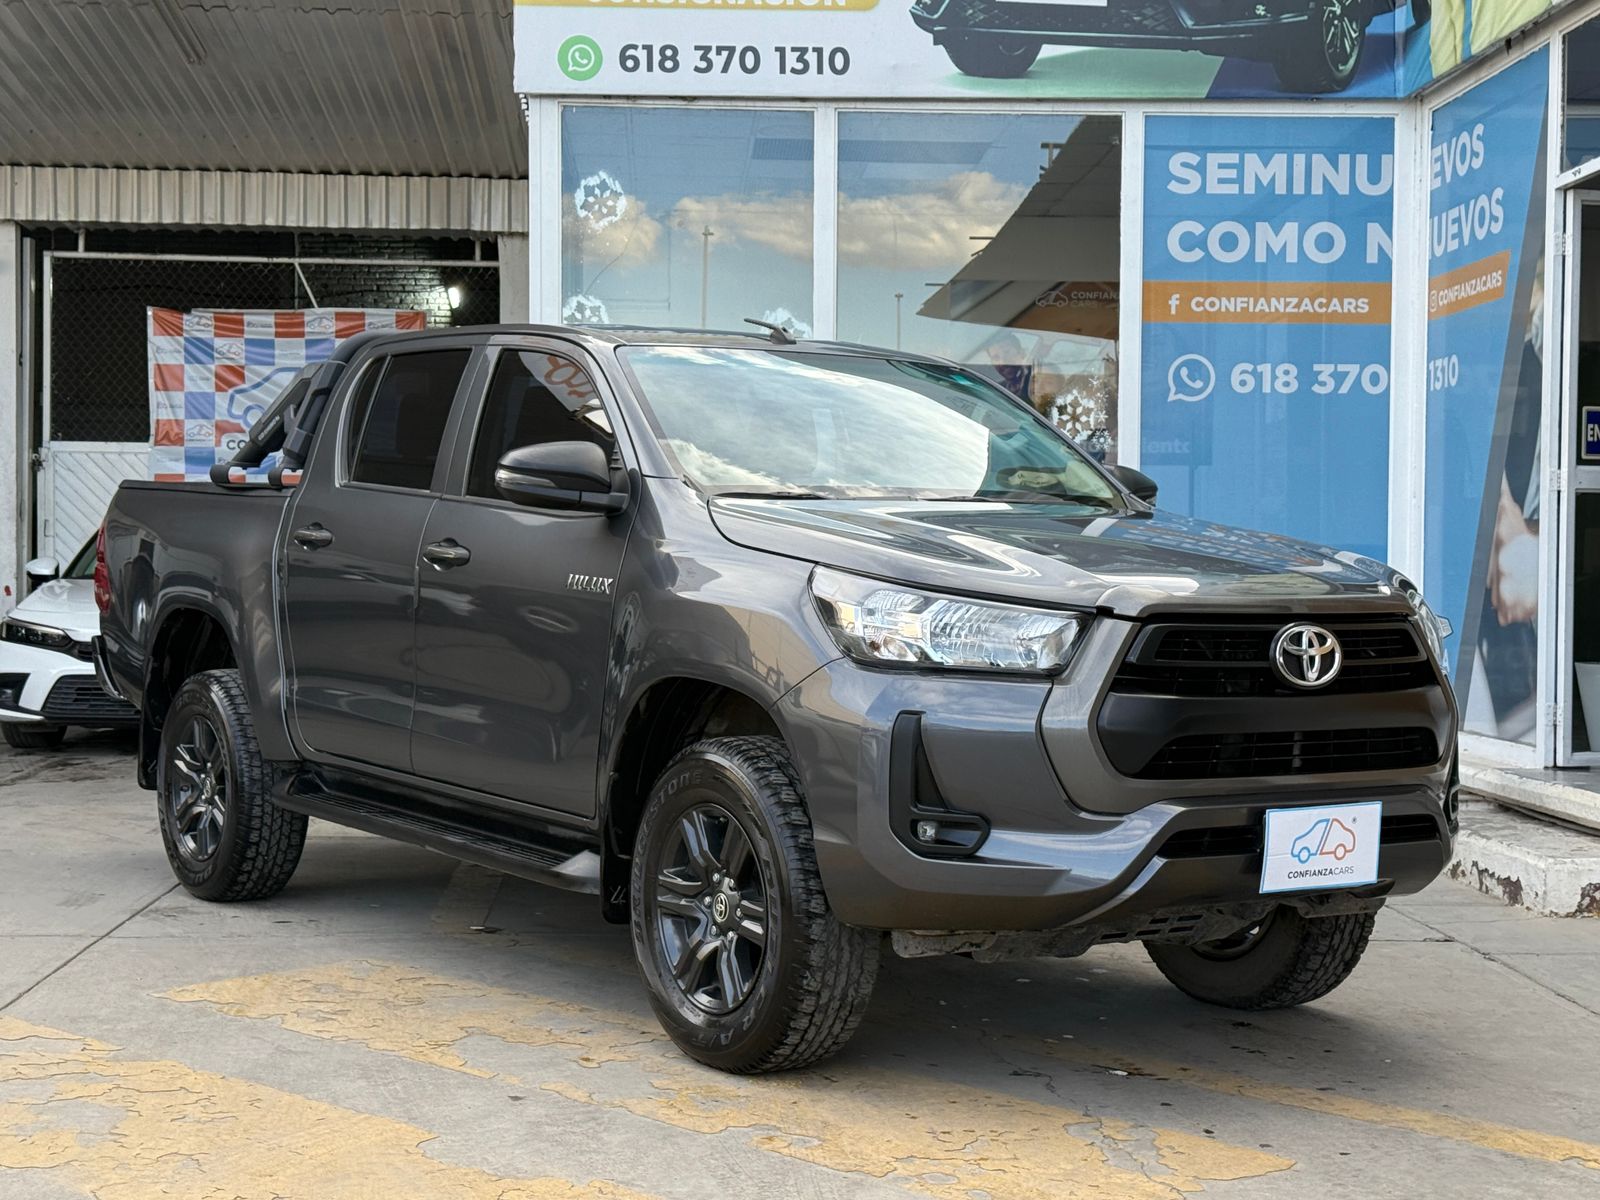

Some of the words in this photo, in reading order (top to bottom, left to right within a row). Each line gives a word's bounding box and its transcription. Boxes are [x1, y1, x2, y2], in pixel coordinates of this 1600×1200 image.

[618, 43, 680, 74] 618
[693, 45, 761, 75] 370
[774, 46, 851, 76] 1310
[1167, 151, 1394, 196] SEMINU
[1430, 122, 1485, 191] EVOS
[1429, 186, 1504, 259] UEVOS
[1166, 220, 1347, 264] COMO
[1190, 296, 1370, 314] CONFIANZACARS
[1439, 270, 1502, 306] CONFIANZACARS
[1230, 362, 1299, 394] 618
[1311, 363, 1389, 395] 370
[1428, 354, 1459, 392] 1310
[1287, 867, 1354, 879] CONFIANZACARS
